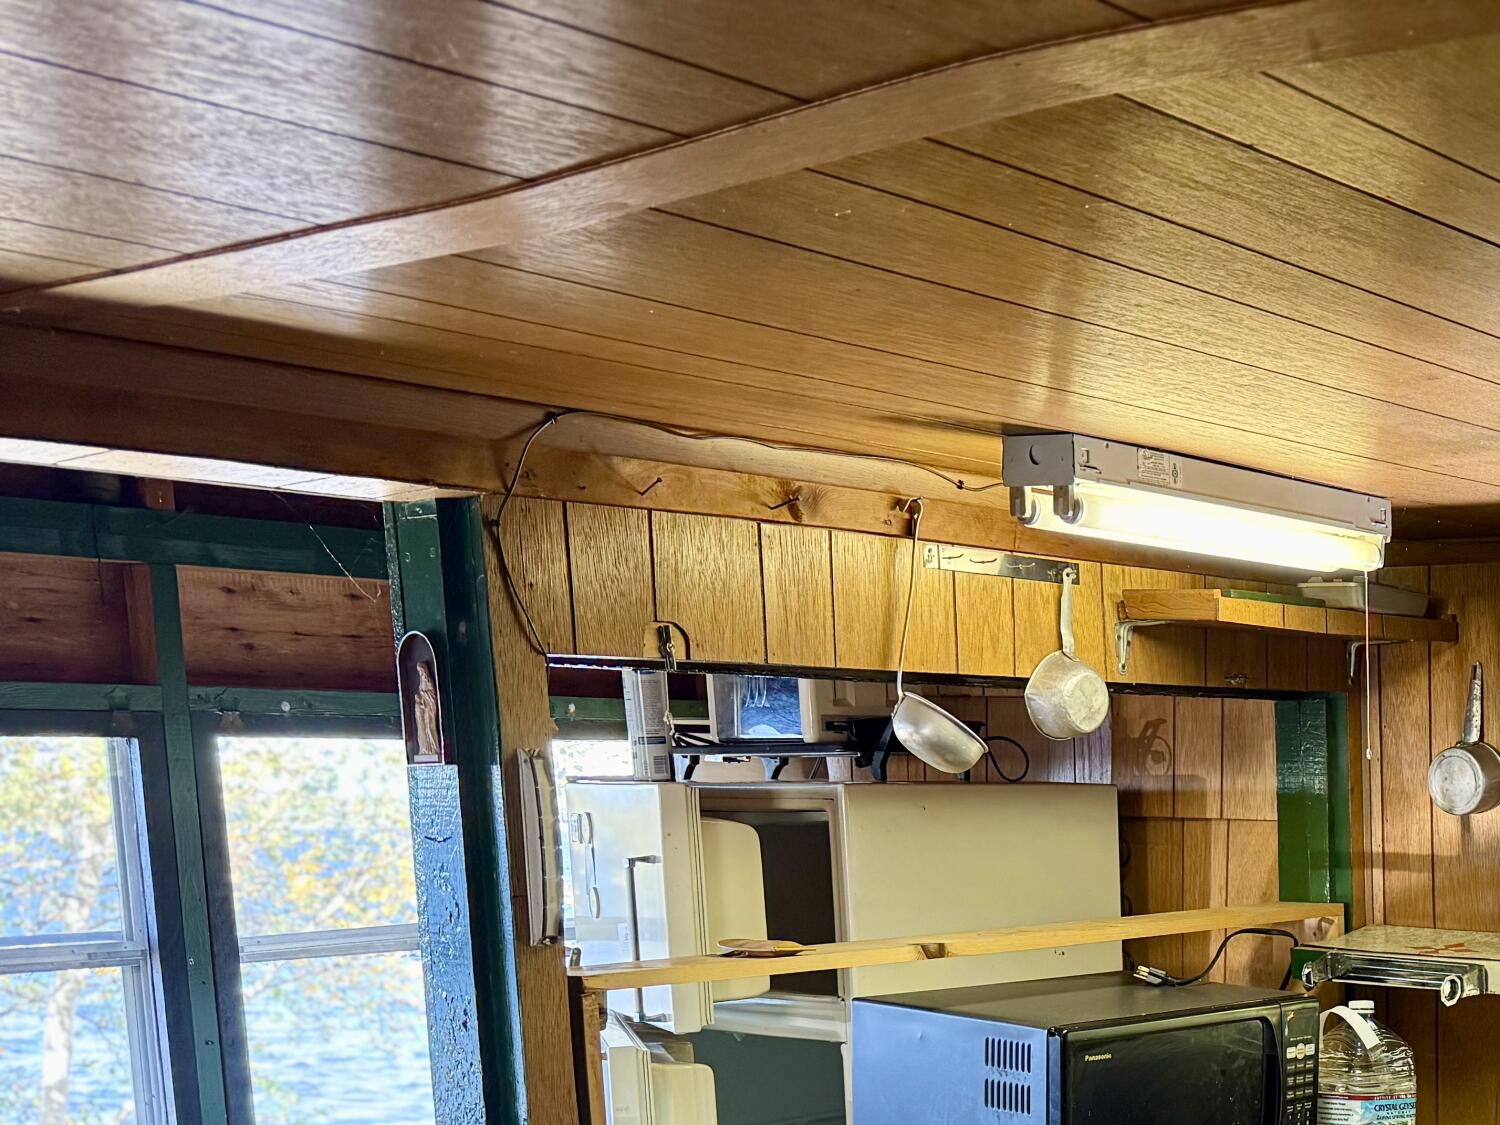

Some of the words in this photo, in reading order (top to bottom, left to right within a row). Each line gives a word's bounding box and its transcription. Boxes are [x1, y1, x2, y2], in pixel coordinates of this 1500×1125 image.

[1084, 1052, 1112, 1062] Panasonic
[1374, 1103, 1398, 1112] CRYSTAL
[1399, 1101, 1416, 1111] GEYS
